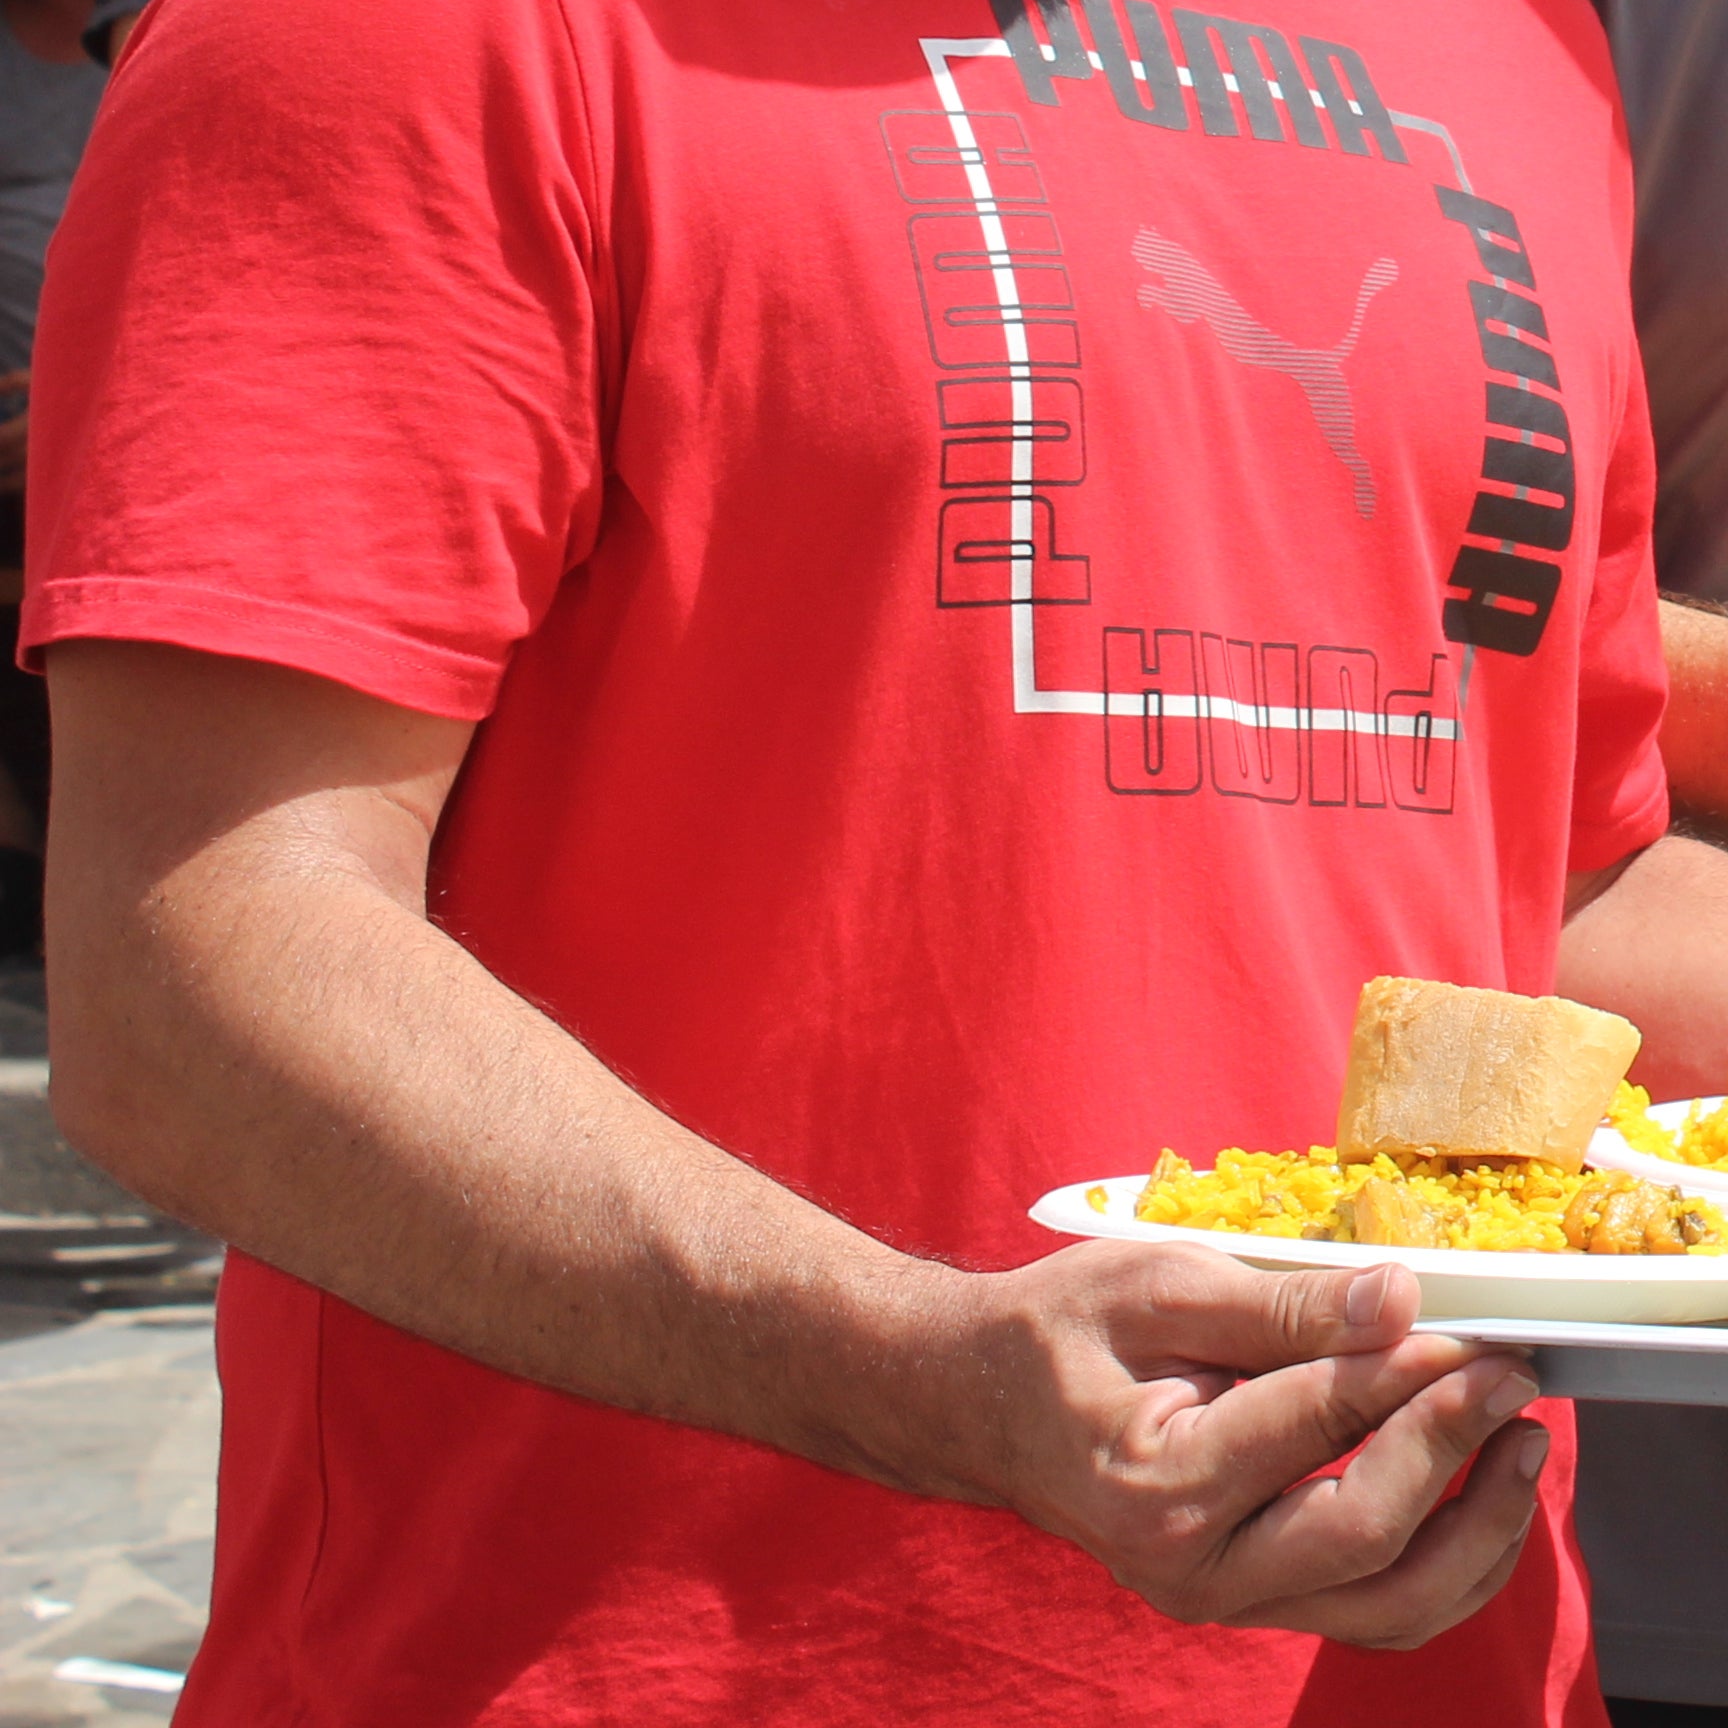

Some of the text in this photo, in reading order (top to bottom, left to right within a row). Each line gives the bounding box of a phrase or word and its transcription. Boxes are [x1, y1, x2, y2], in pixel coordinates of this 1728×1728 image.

[878, 109, 1093, 610] PUMA
[1432, 182, 1577, 658] PUMA
[1102, 625, 1465, 815] PUMA
